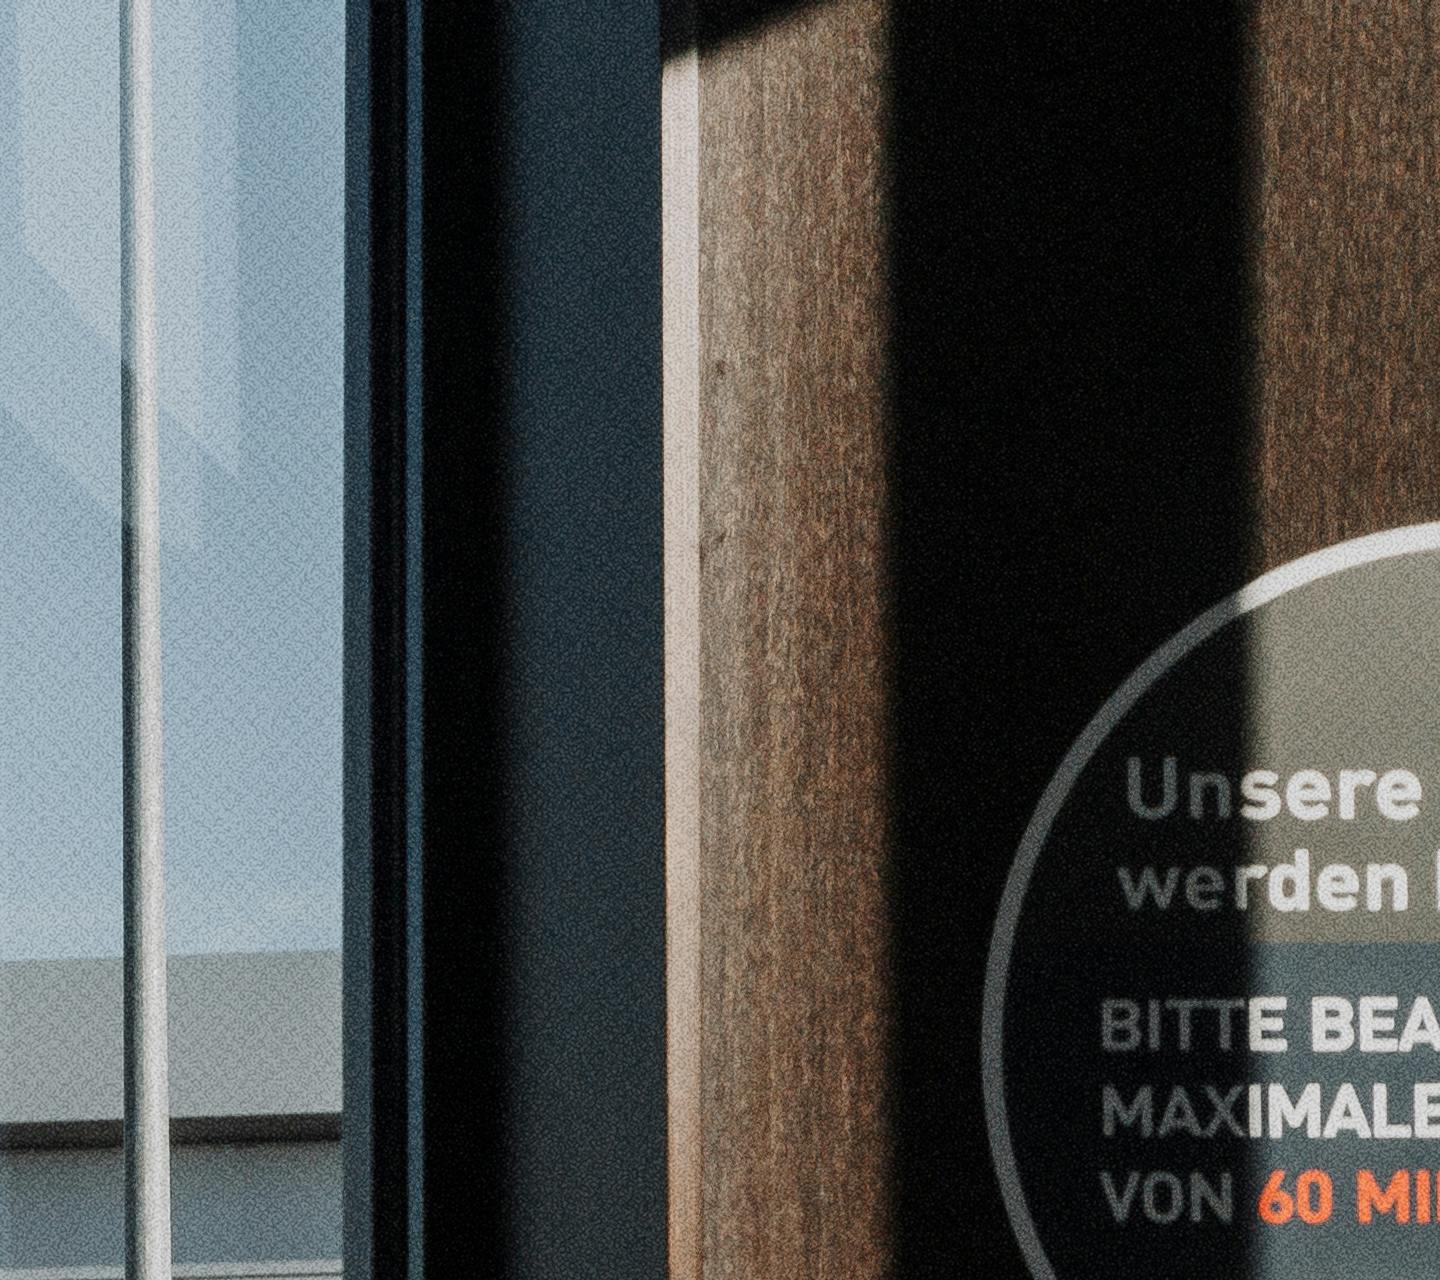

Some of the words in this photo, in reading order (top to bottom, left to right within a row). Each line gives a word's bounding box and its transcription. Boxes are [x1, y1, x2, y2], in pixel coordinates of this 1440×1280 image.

[1127, 757, 1421, 821] Unsere
[1118, 848, 1409, 912] werden
[1100, 995, 1288, 1054] BITTE
[1311, 996, 1440, 1053] BEA
[1101, 1080, 1440, 1139] MAXIMALE
[1101, 1169, 1233, 1226] VON
[1257, 1167, 1333, 1225] 60
[1356, 1168, 1440, 1225] MI
